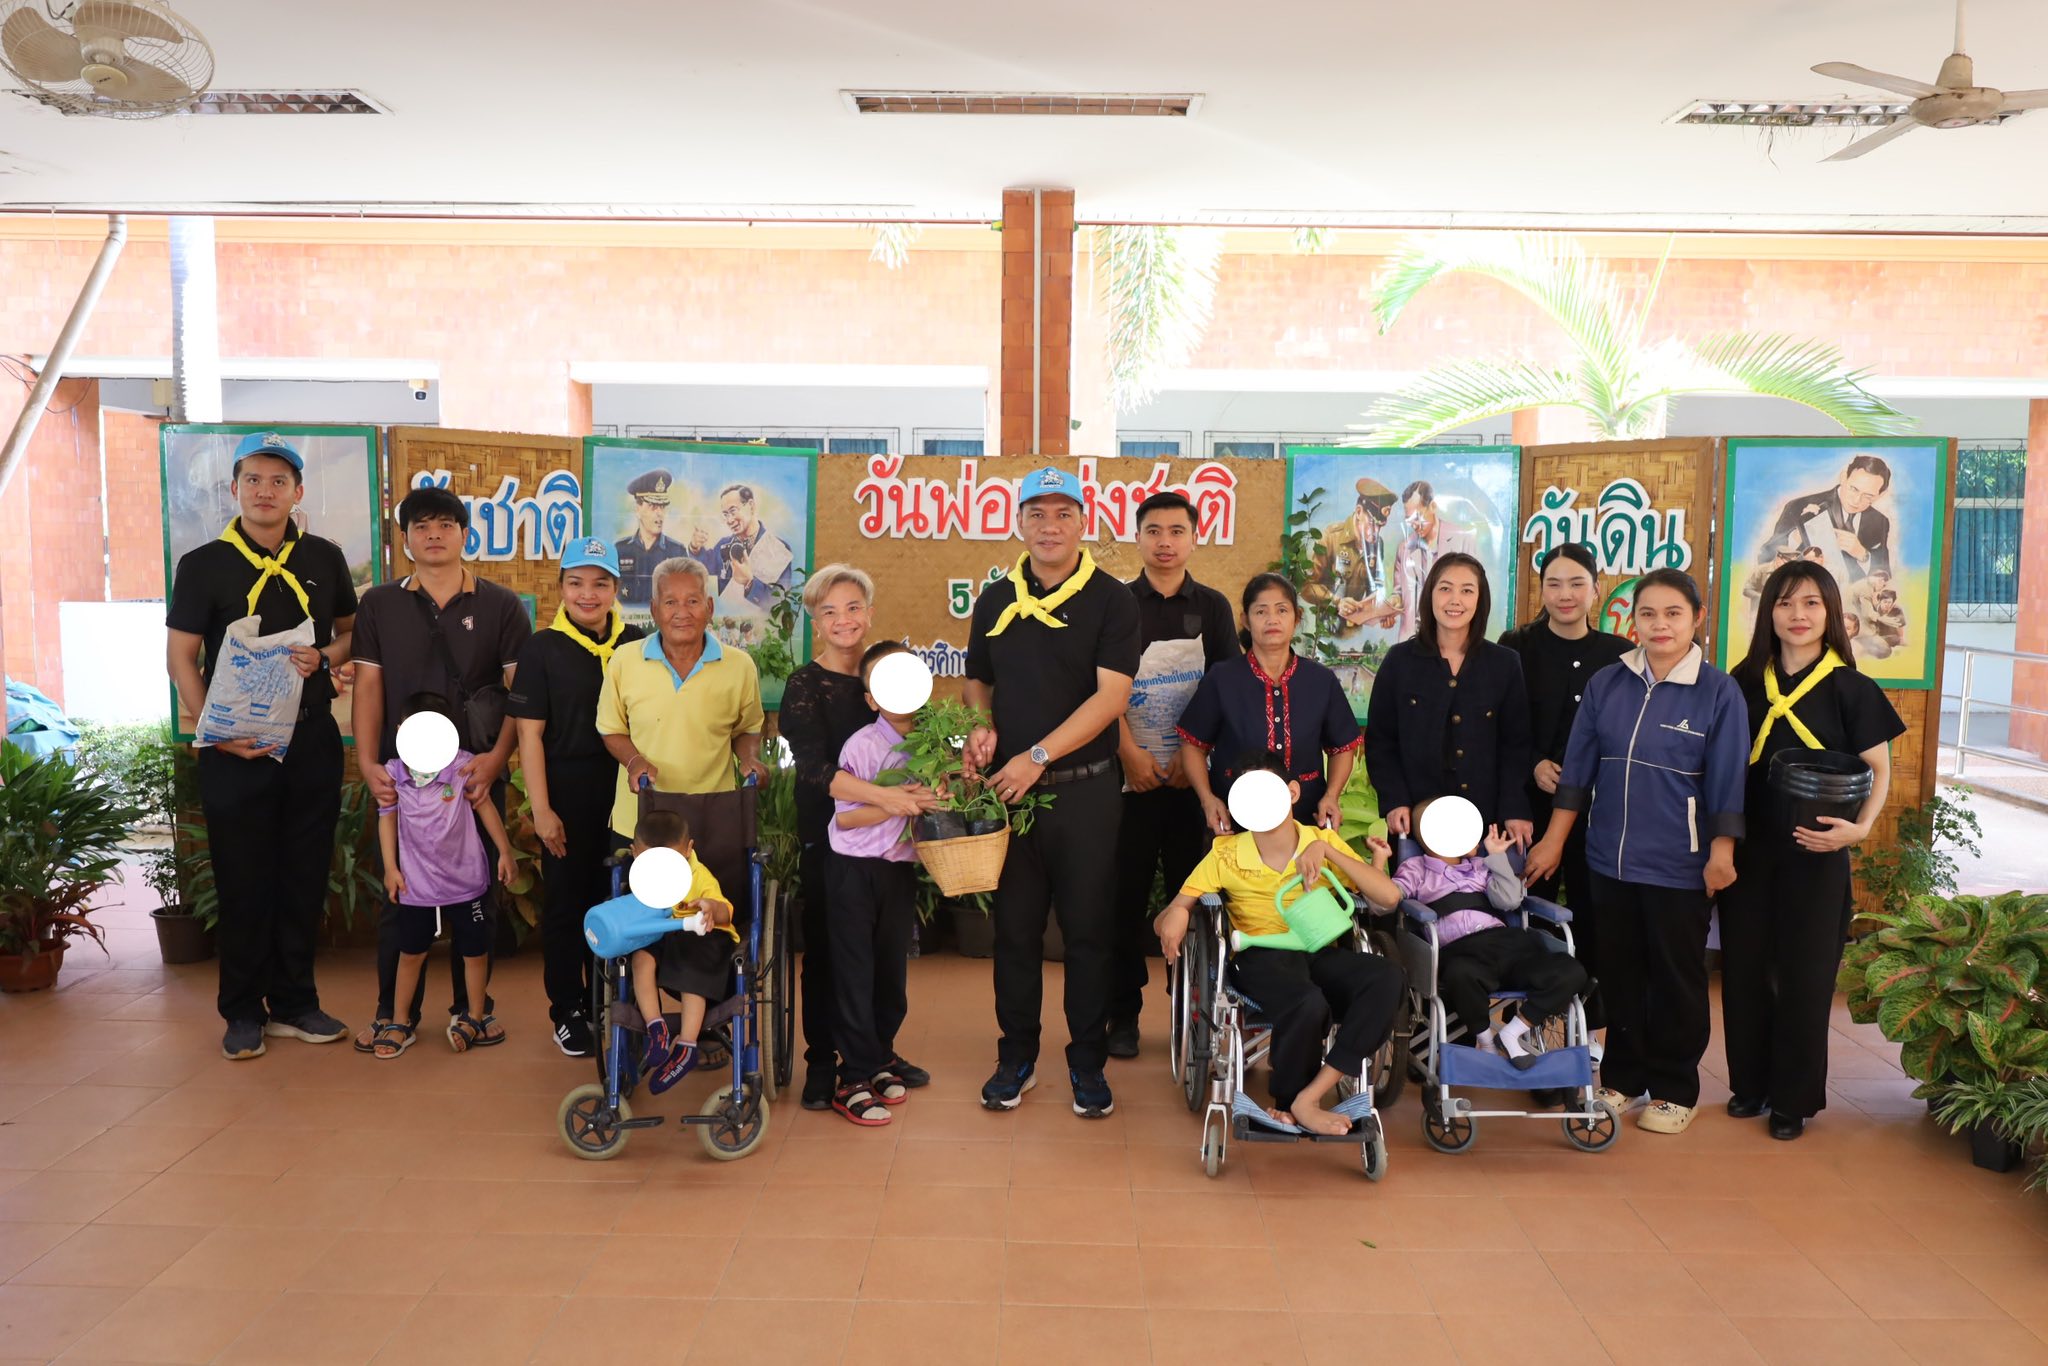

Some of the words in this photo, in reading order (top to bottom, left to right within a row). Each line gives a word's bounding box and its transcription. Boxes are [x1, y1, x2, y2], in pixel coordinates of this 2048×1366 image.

[1525, 481, 1685, 569] วันดิน
[952, 582, 970, 615] 5
[471, 900, 485, 923] NYC
